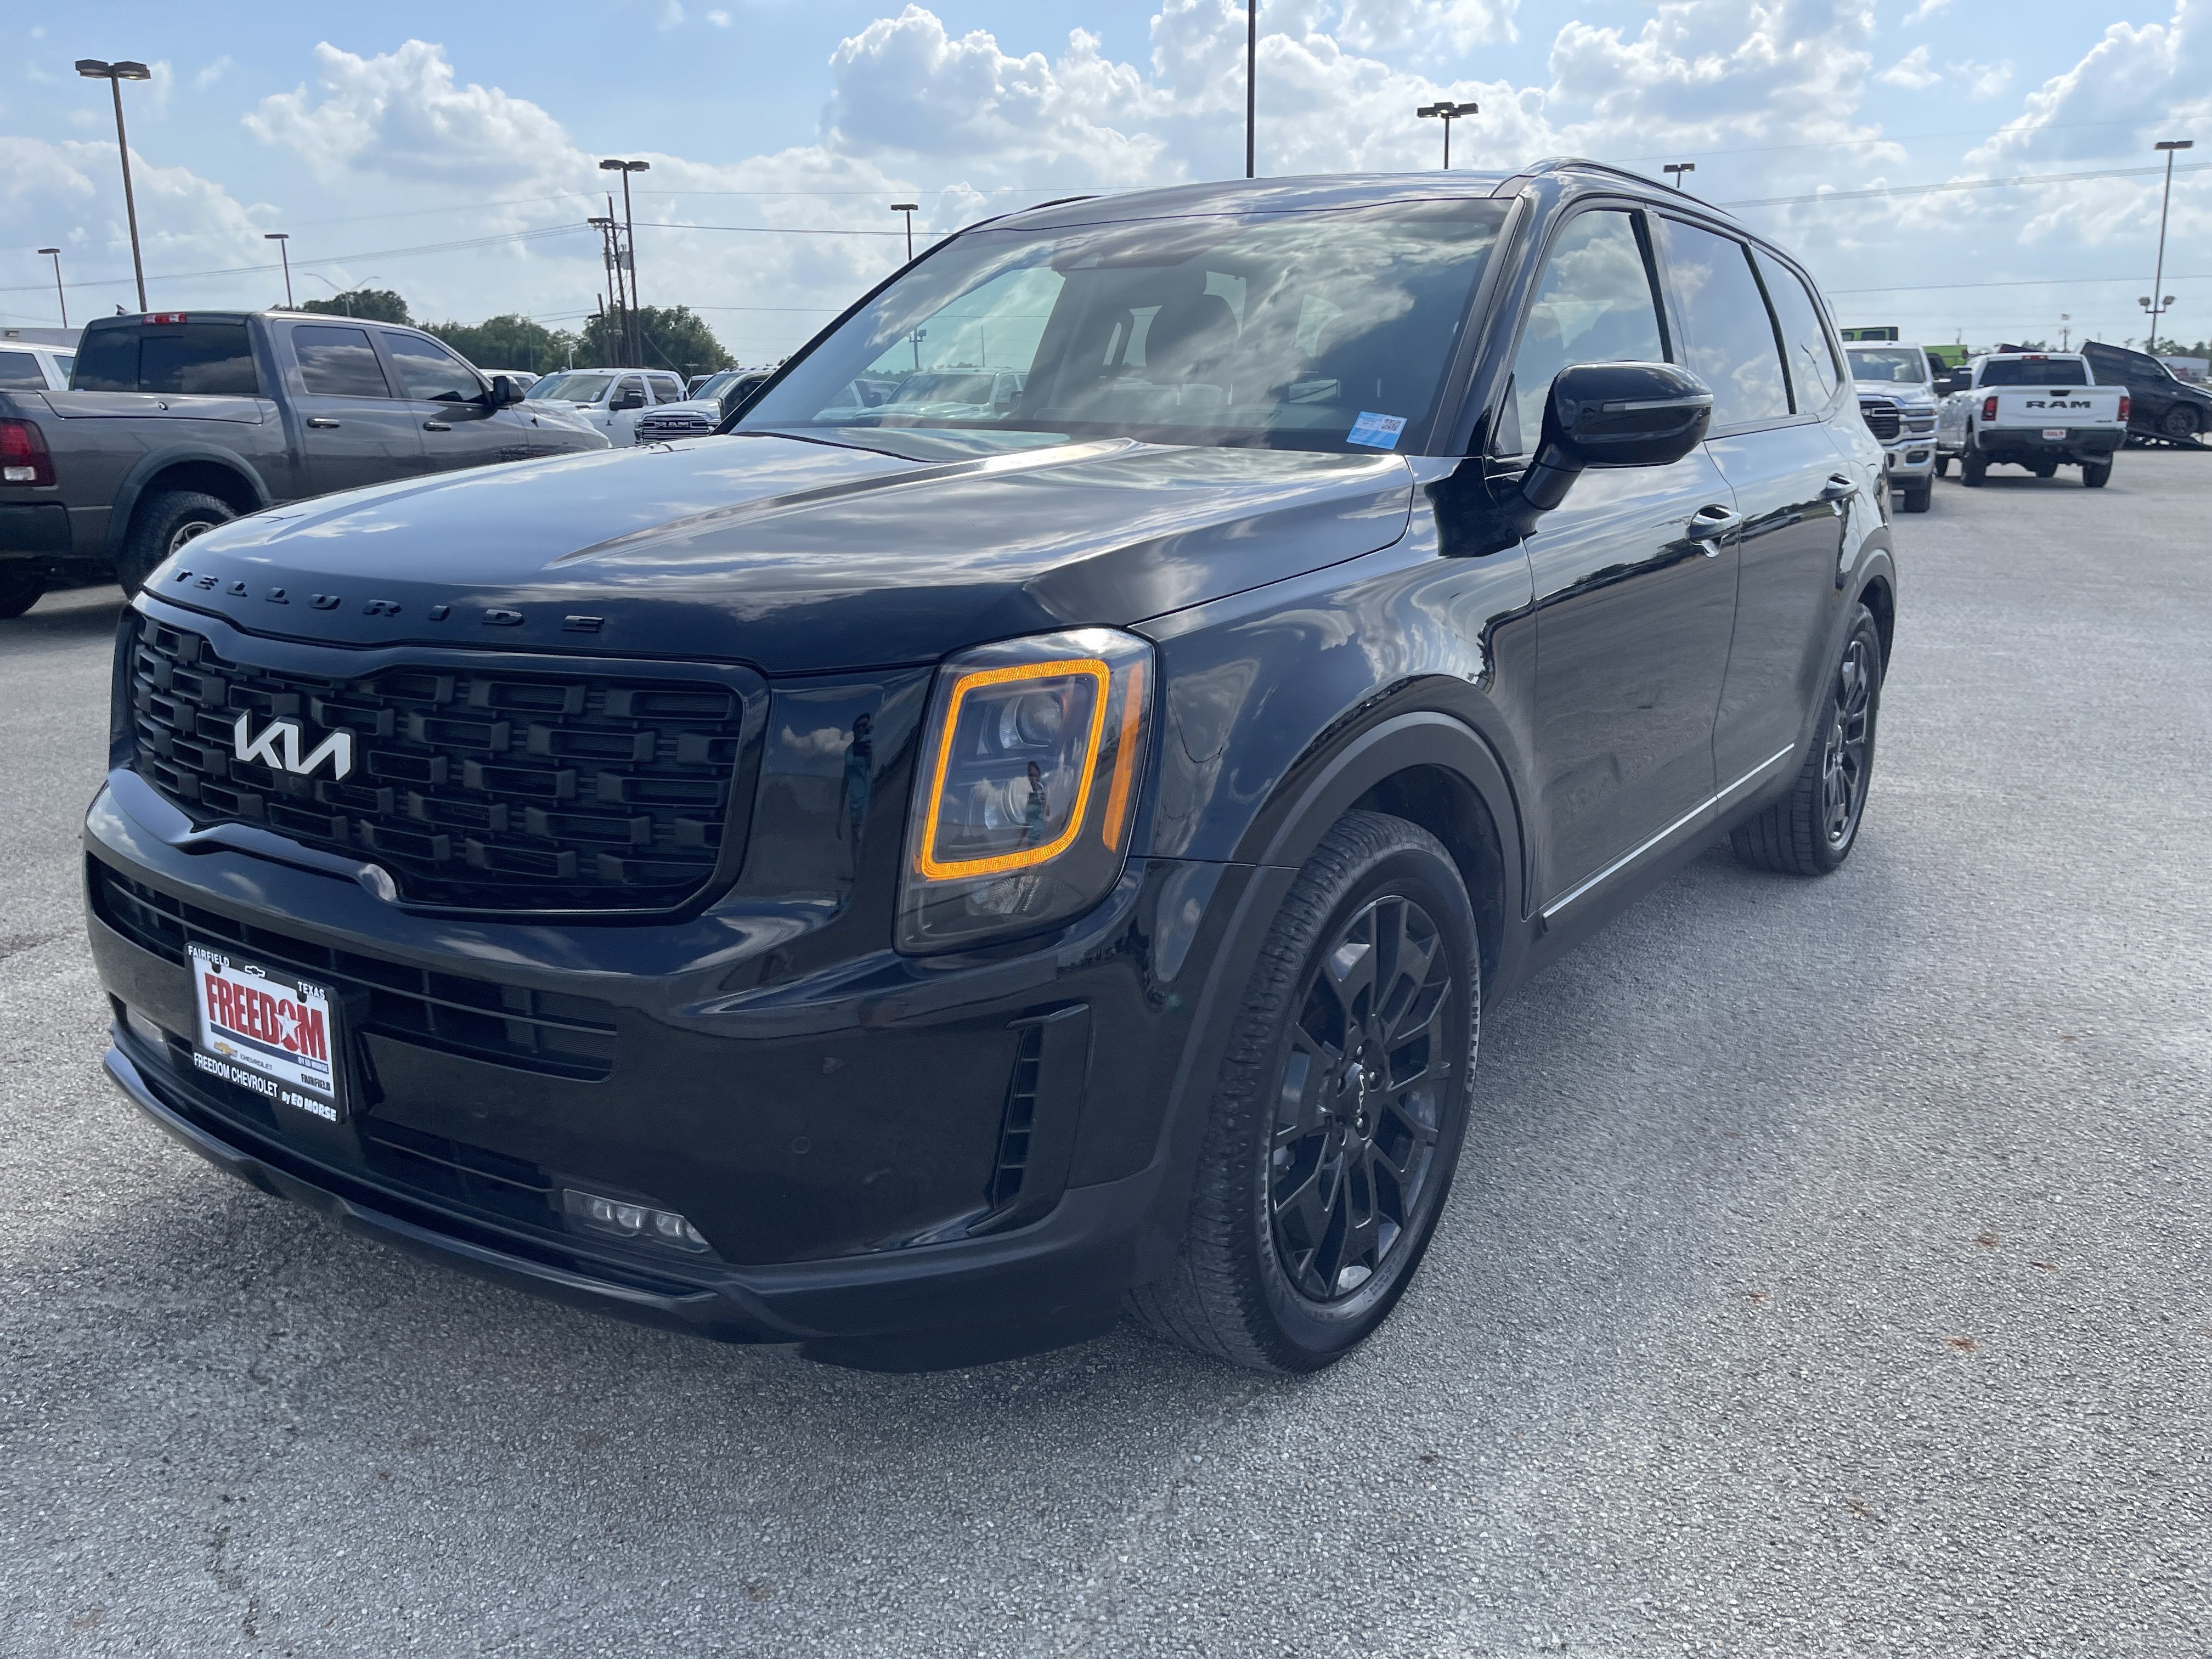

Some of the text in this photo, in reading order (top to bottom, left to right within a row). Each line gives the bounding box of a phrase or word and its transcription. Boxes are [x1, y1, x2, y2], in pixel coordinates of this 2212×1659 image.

[173, 567, 605, 634] TELLURIDE
[234, 710, 352, 781] KIA
[188, 945, 230, 968] FAIRFIELD
[297, 981, 326, 1000] TEXAS
[204, 972, 328, 1062] FREEDOM
[1465, 959, 1480, 1085] MICHELIN
[193, 1052, 230, 1080] FREEDOM
[230, 1066, 279, 1098] CHEVROLET
[291, 1092, 303, 1108] ED
[304, 1097, 337, 1122] MORSE
